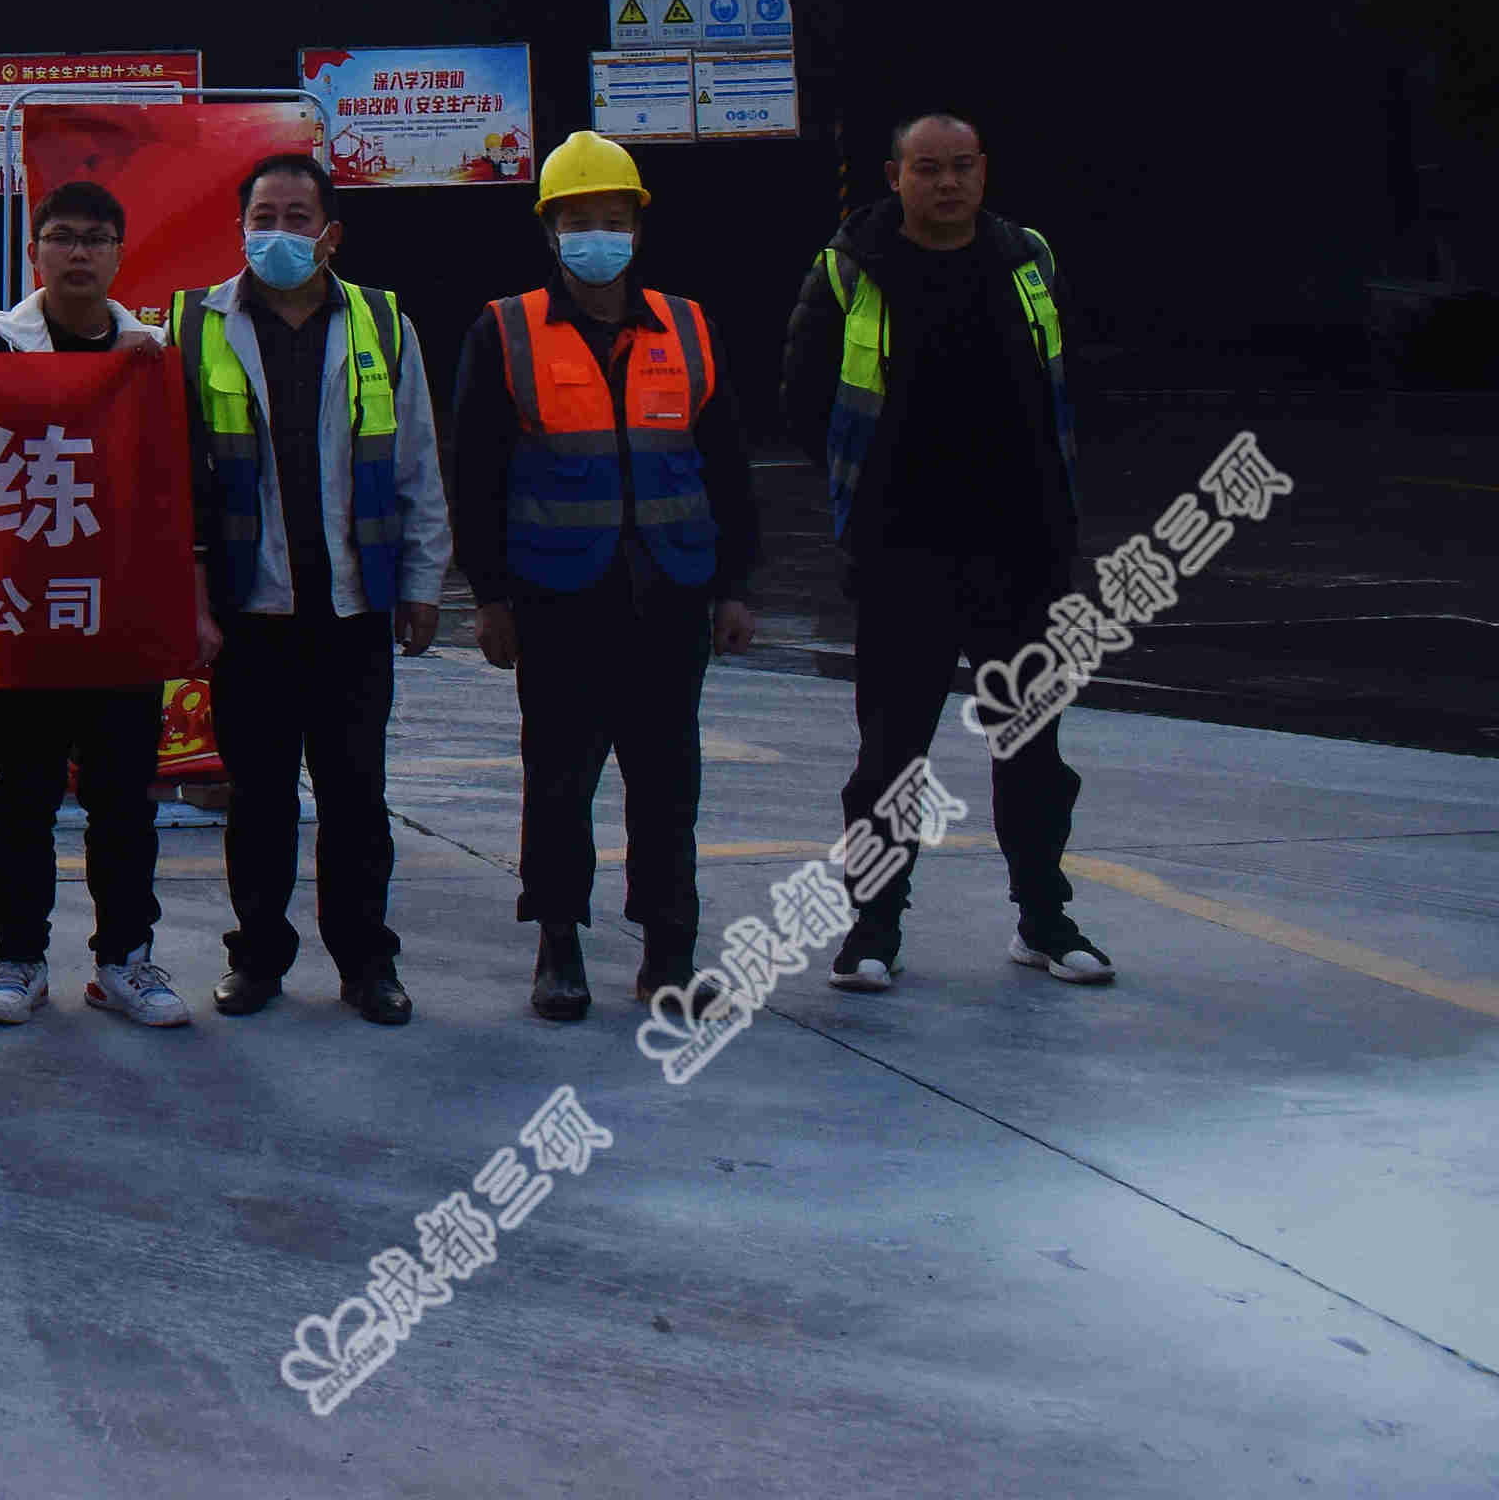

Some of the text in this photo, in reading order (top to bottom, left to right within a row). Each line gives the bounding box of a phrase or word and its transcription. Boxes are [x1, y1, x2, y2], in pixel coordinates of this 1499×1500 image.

[21, 63, 165, 80] 新安全生产法的十大亮点
[374, 70, 465, 91] 深入学习贯彻
[337, 94, 504, 117] 新修改的《安全生产法》
